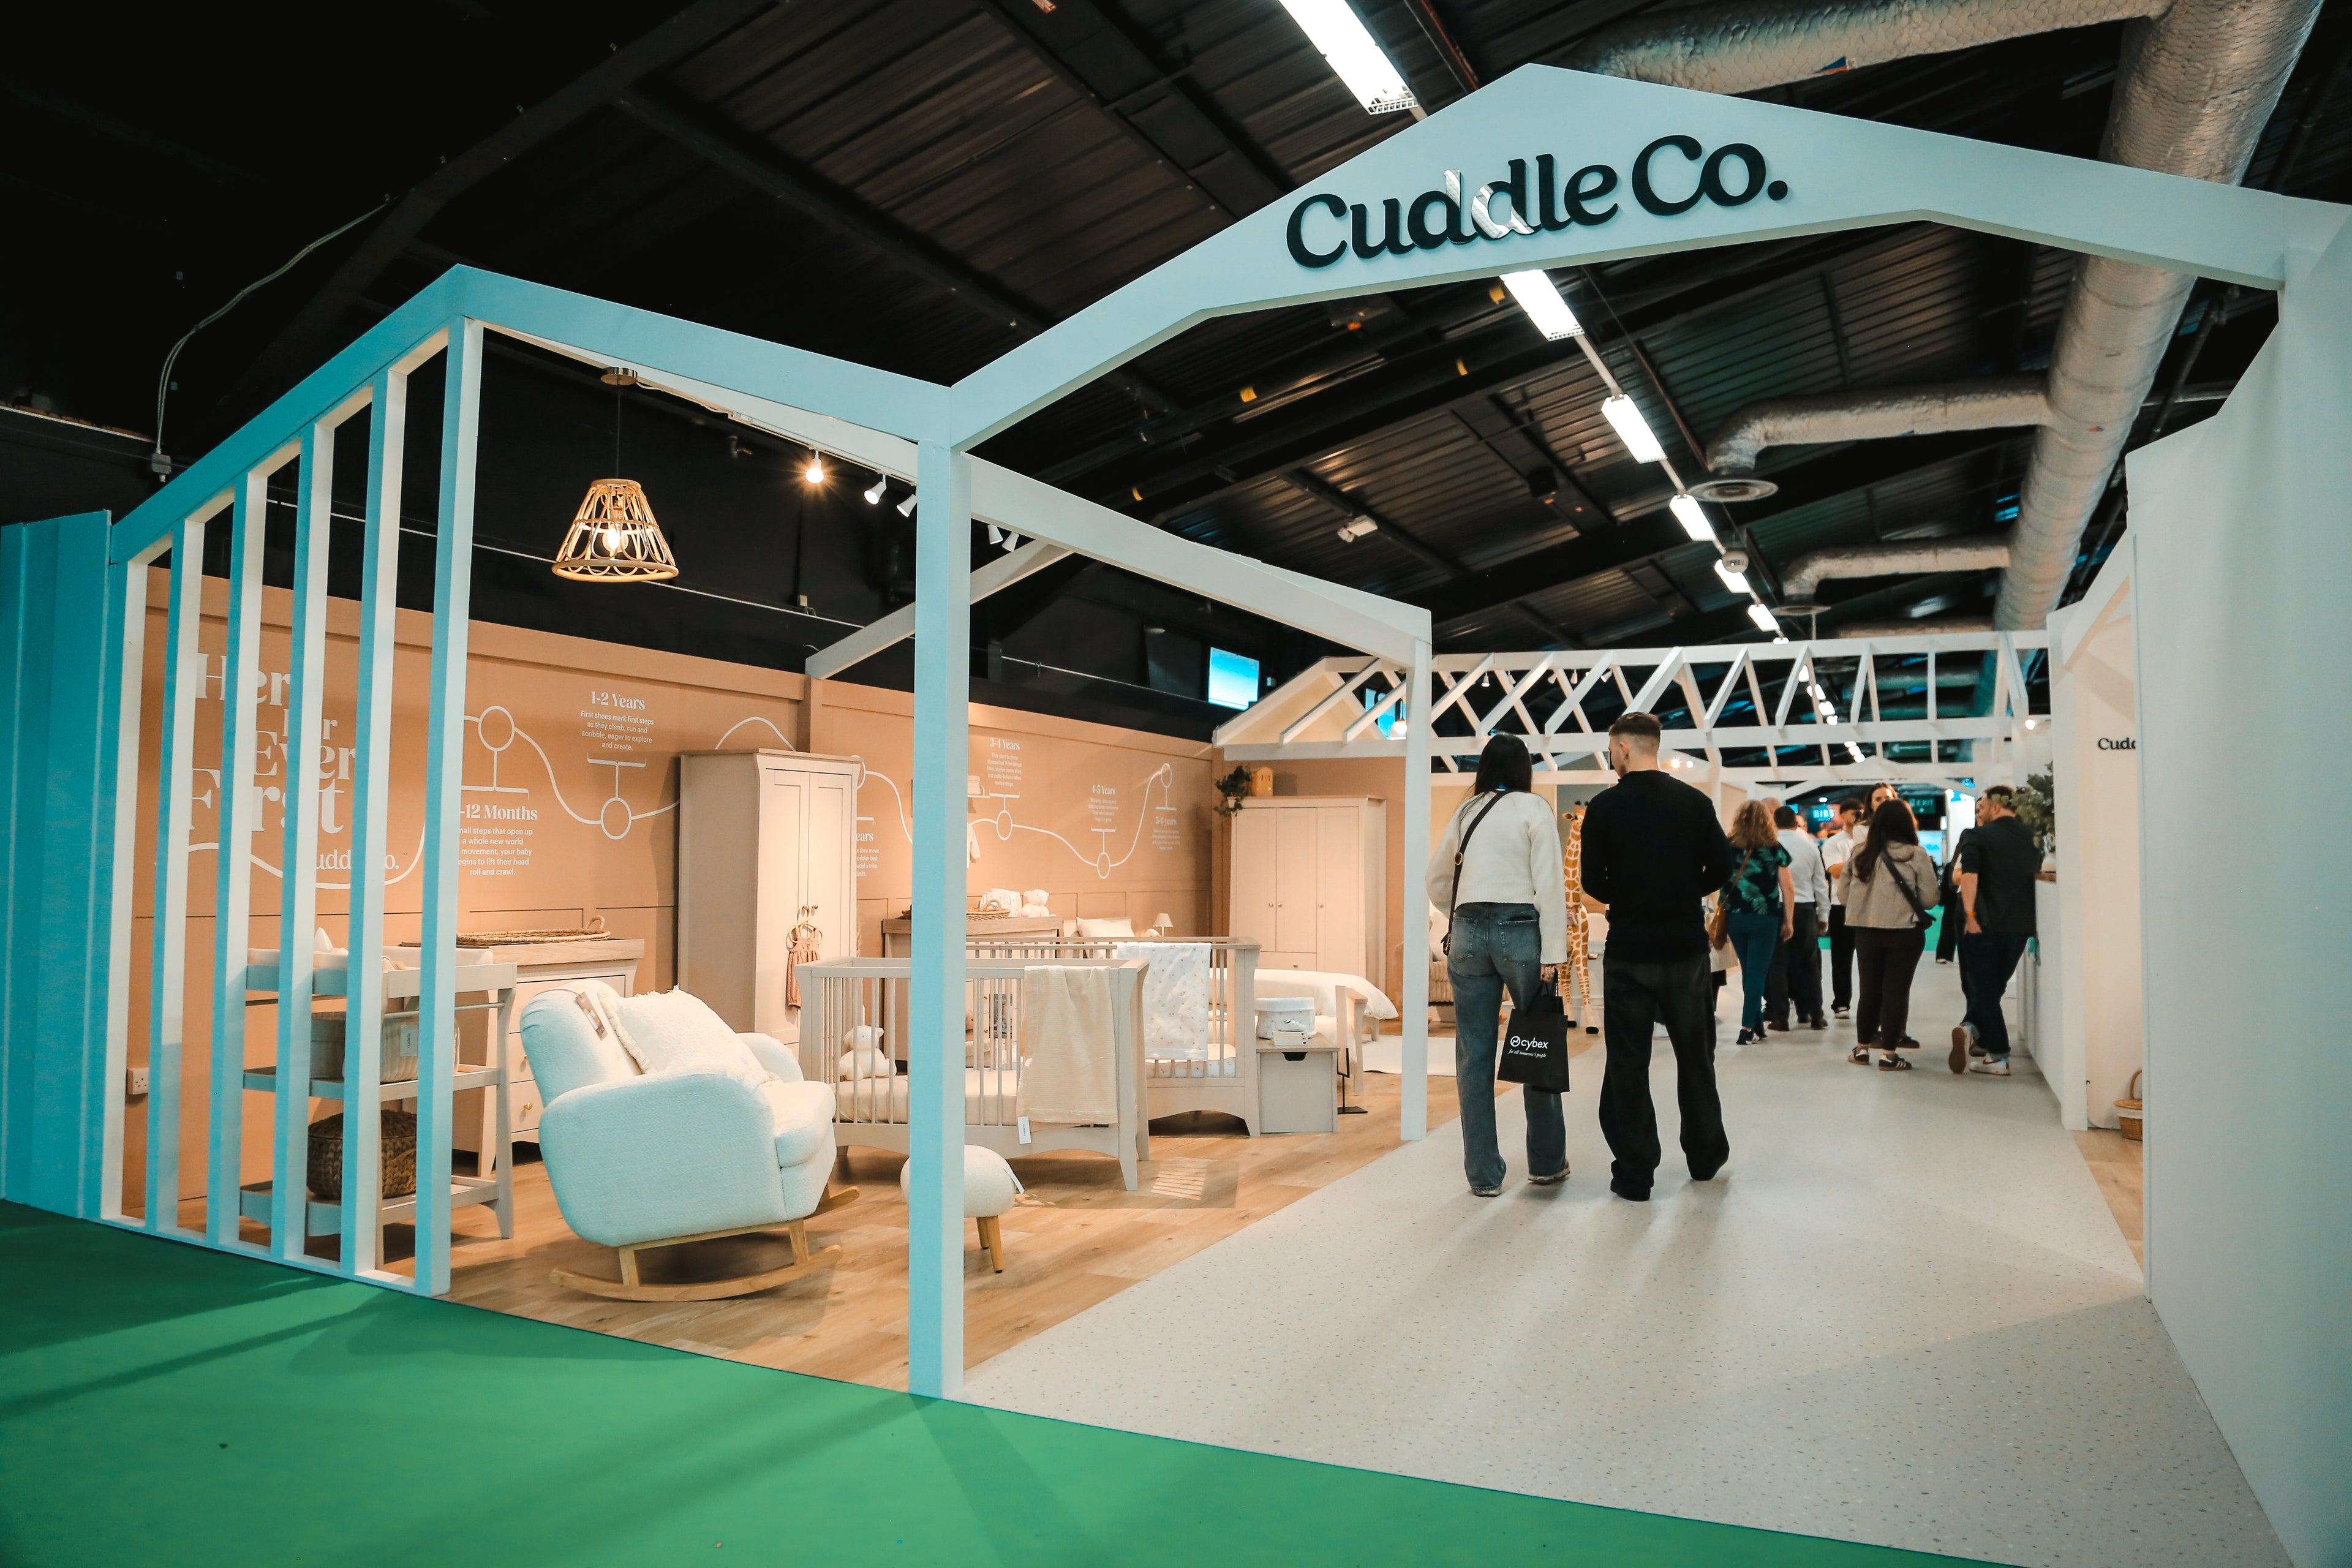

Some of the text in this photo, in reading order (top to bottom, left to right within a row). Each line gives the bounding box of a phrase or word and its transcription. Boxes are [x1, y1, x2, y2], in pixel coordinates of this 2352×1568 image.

[1286, 134, 1789, 268] Cuddle Co.
[592, 691, 646, 710] 1-2 Years
[595, 722, 608, 730] they
[582, 730, 606, 739] scribble,
[1002, 739, 1020, 750] Years
[460, 804, 538, 820] -12 Months
[856, 833, 874, 842] ears
[516, 848, 532, 856] baby
[1521, 1037, 1548, 1050] cybex
